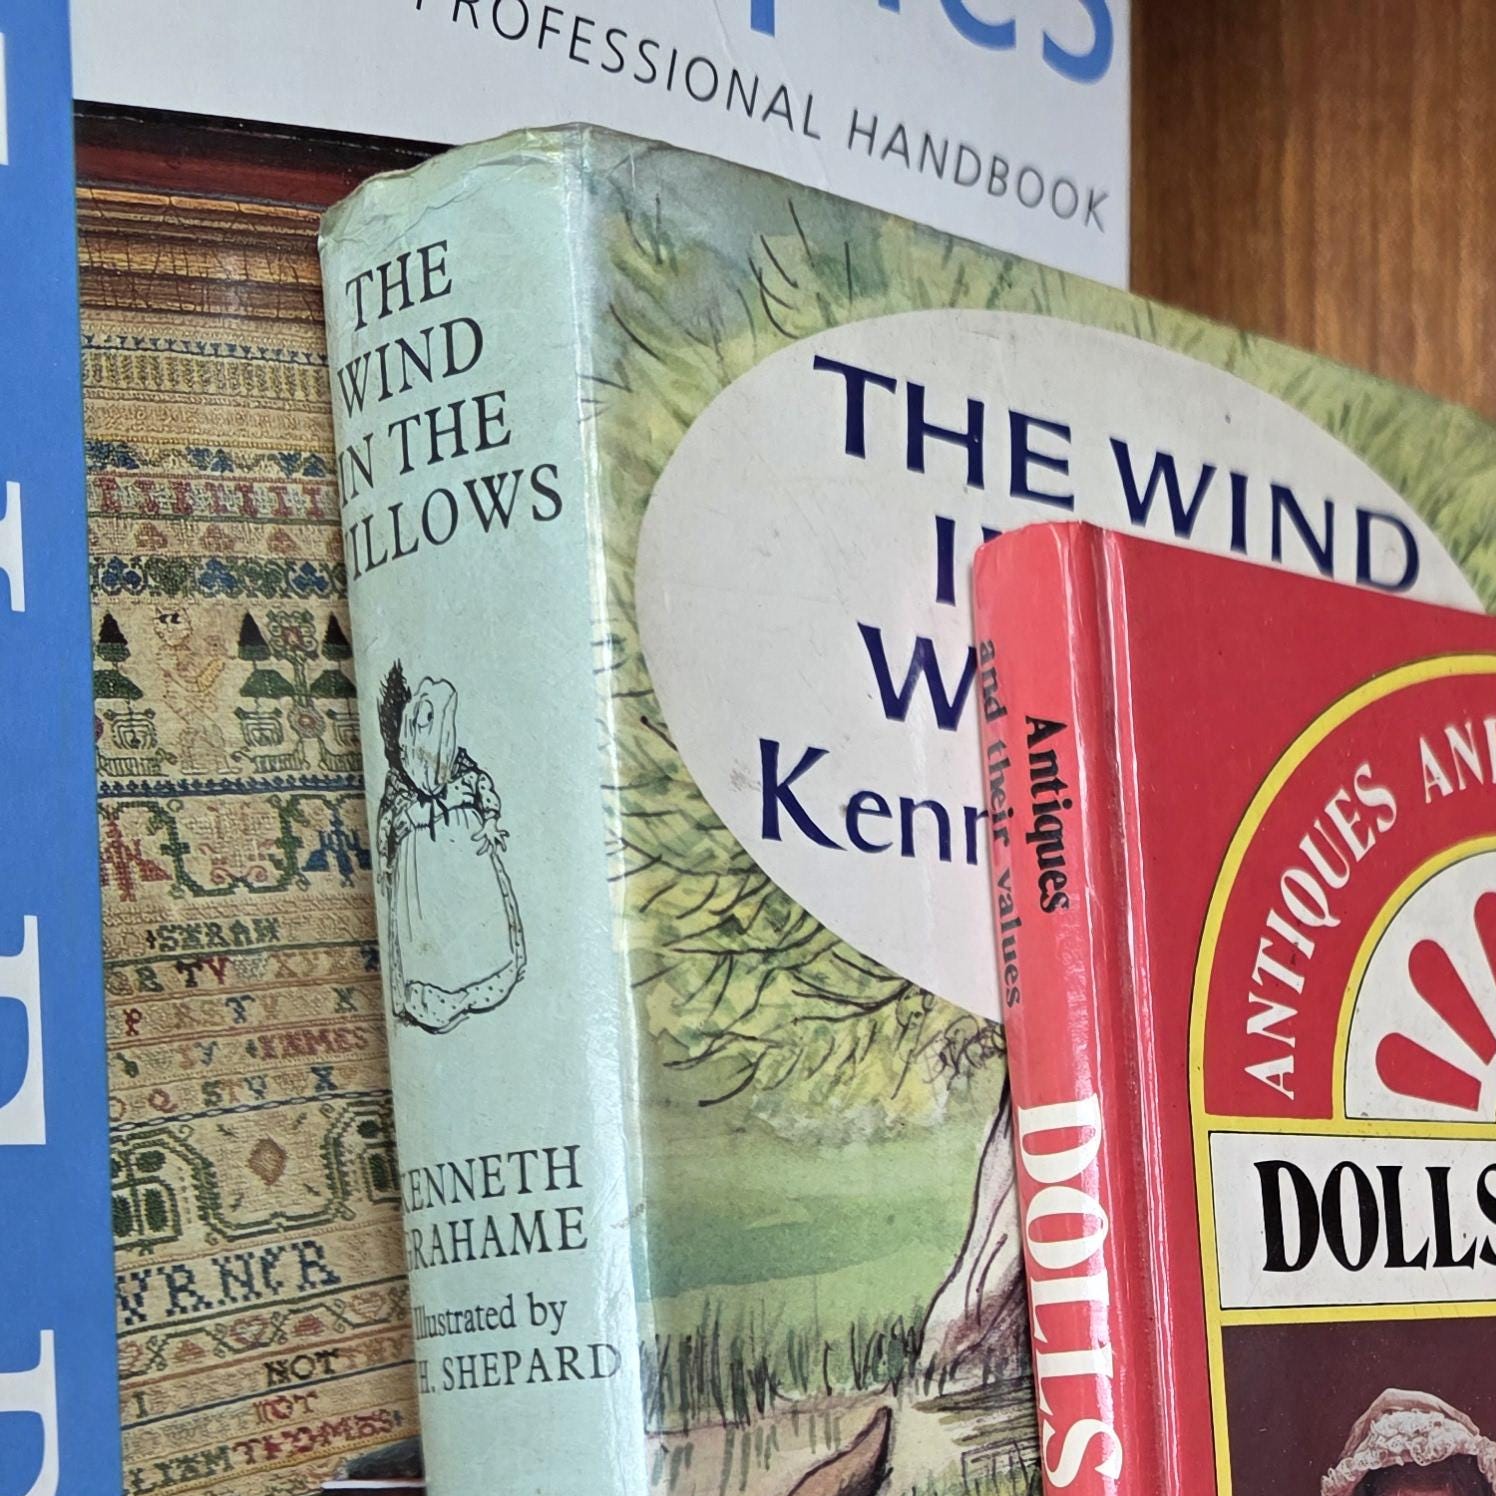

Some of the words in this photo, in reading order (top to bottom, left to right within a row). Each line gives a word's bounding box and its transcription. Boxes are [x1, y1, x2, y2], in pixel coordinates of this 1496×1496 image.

[416, 0, 820, 140] ROFESSIONAL
[848, 109, 1109, 233] HANDBOOK
[345, 240, 452, 331] THE
[337, 317, 483, 418] WIND
[388, 390, 511, 475] THE
[813, 355, 1075, 511] THE
[1109, 437, 1420, 594] WIND
[346, 464, 562, 581] ILLOWS
[935, 515, 1002, 606] I
[979, 638, 1008, 722] and
[987, 740, 1014, 847] their
[1024, 715, 1071, 913] Antiques
[997, 870, 1022, 1008] values
[1244, 763, 1398, 1100] ANTIQUES
[414, 1293, 516, 1340] Illustrated
[526, 1291, 568, 1336] by
[1017, 1093, 1123, 1488] DOLLS
[443, 1344, 621, 1391] SHEPARD
